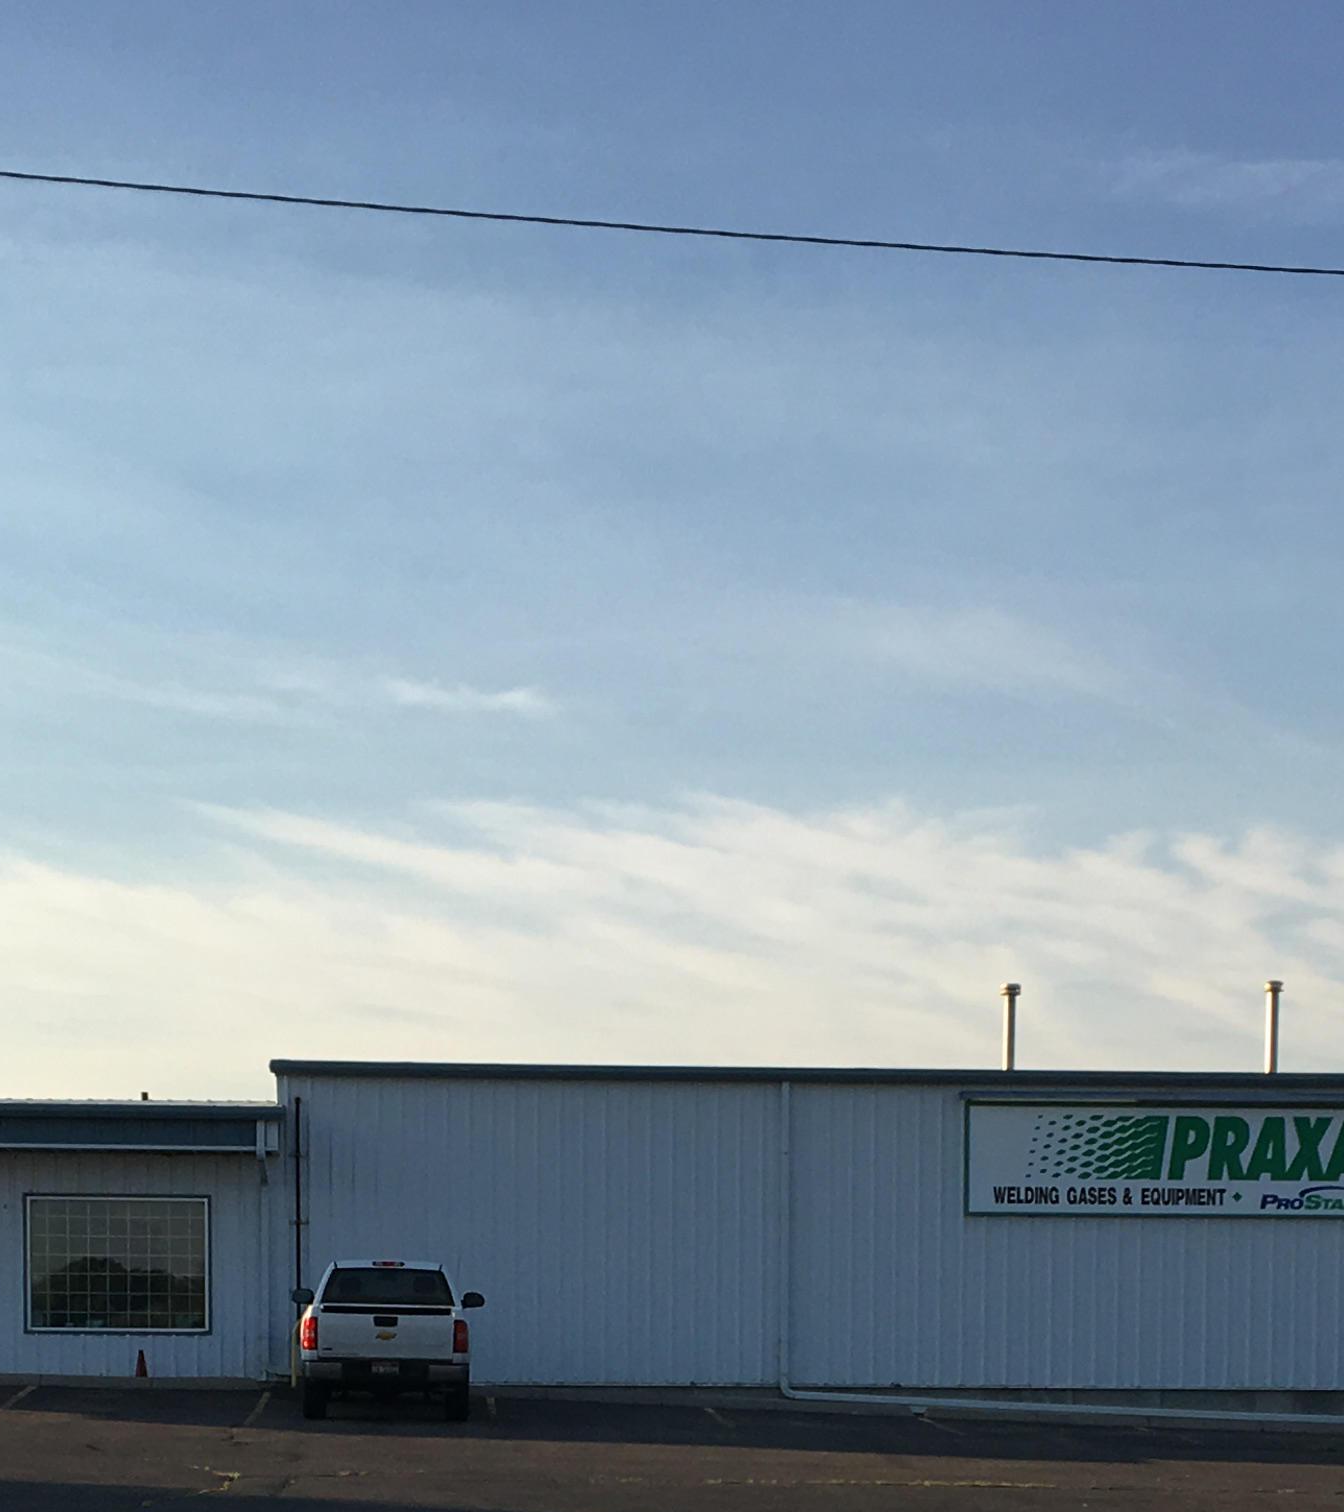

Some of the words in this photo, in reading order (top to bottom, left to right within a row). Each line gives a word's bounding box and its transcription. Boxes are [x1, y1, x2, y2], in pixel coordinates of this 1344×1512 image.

[992, 1186, 1060, 1205] WELDING
[1066, 1187, 1118, 1205] GASES
[1122, 1187, 1133, 1205] &
[1140, 1188, 1227, 1206] EQUIPMENT
